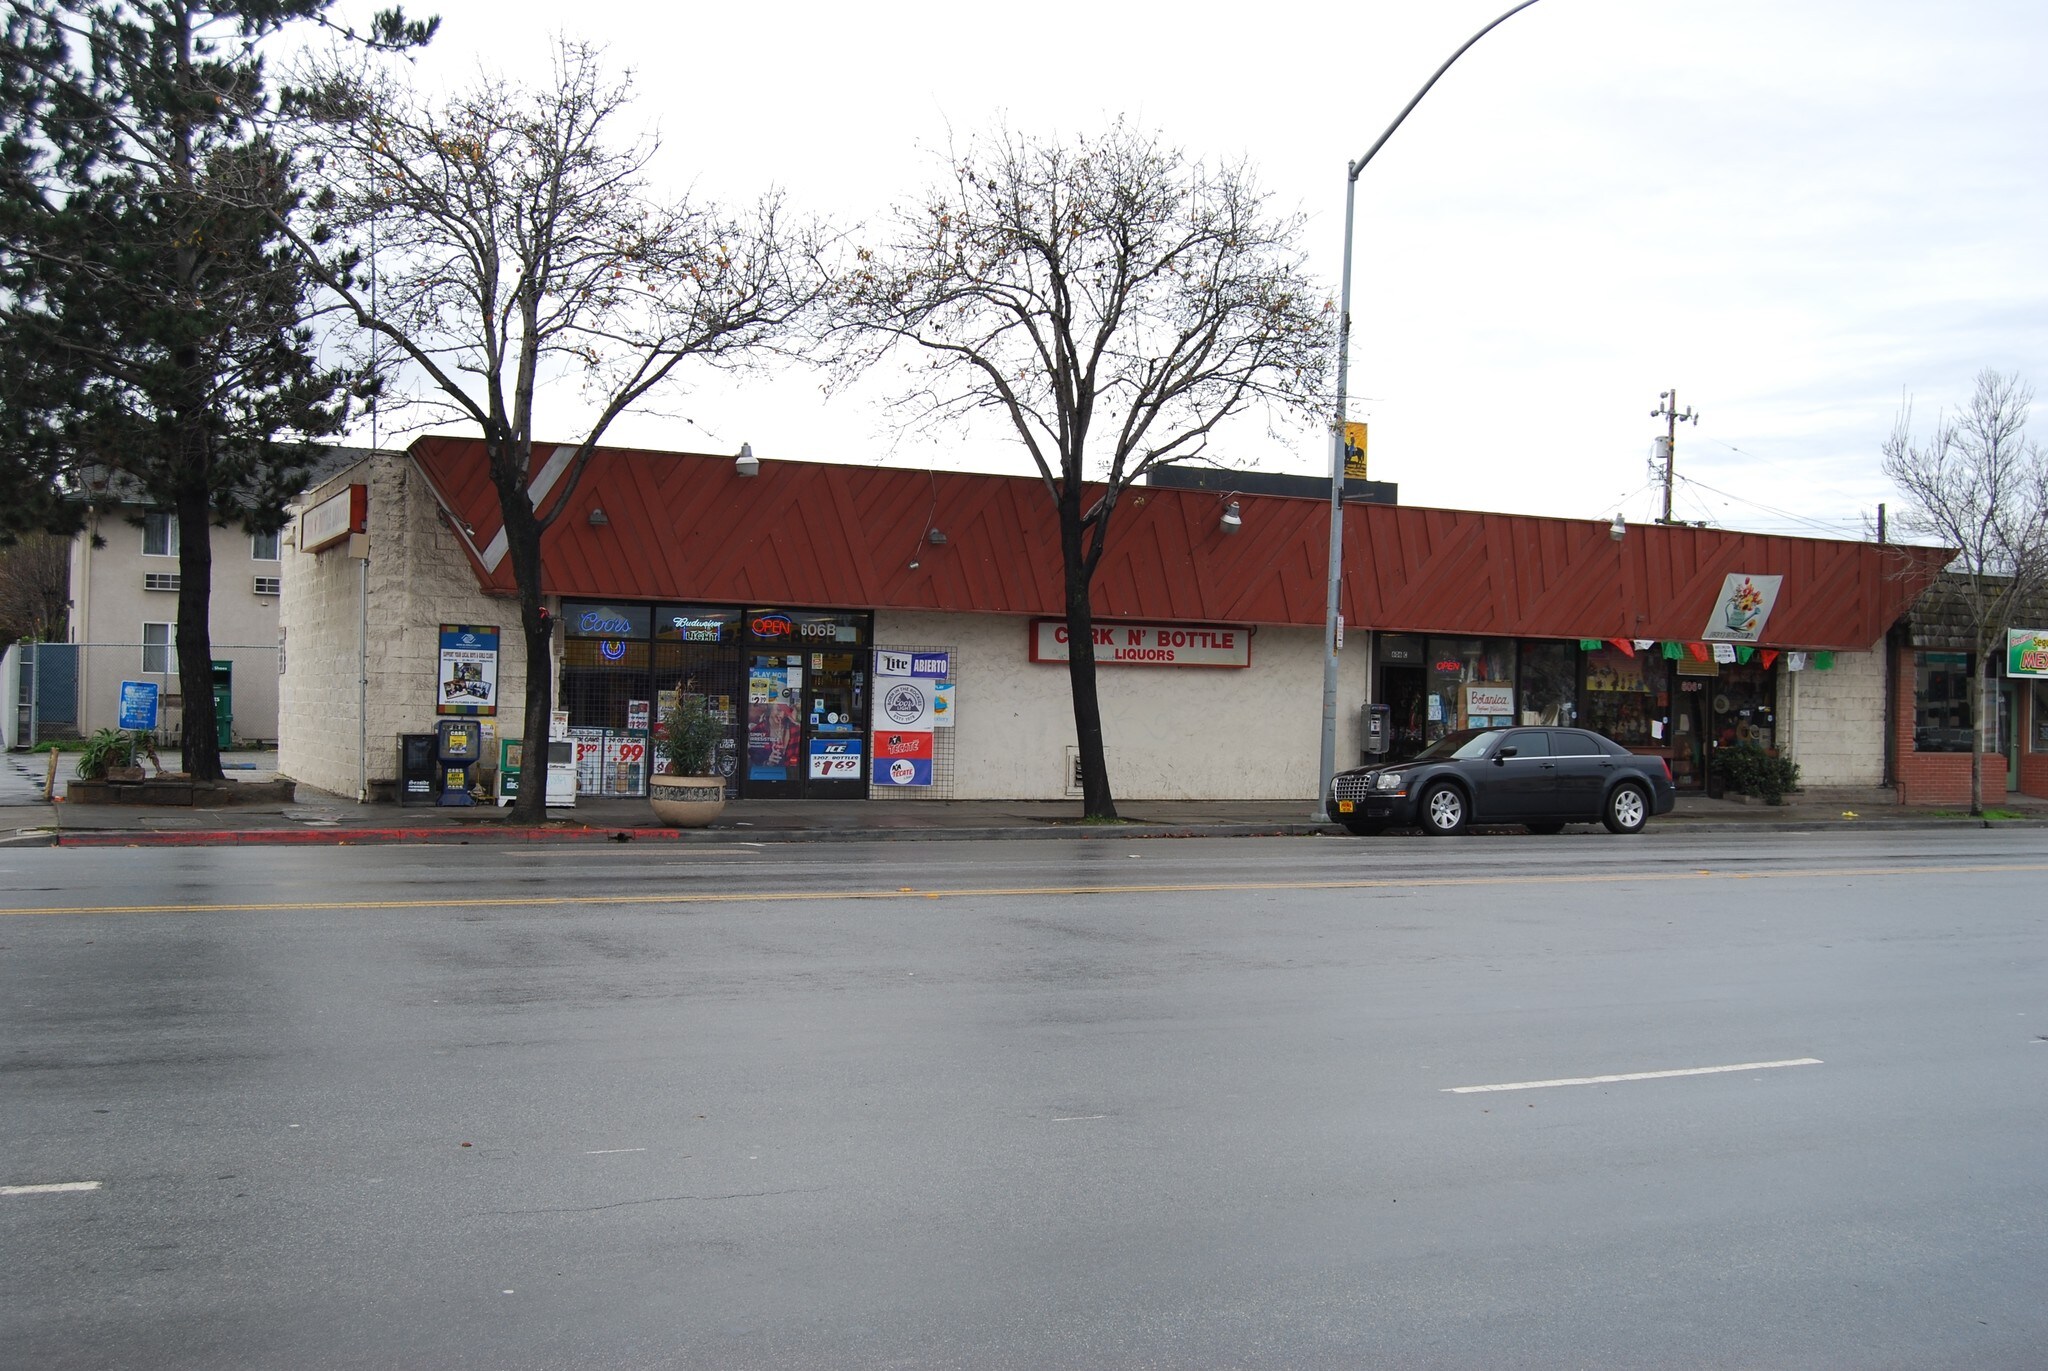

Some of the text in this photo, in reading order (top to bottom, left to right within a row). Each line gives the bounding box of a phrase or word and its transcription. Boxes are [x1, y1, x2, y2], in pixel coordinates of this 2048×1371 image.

[579, 612, 631, 632] Coors
[752, 619, 789, 634] OPEN
[686, 630, 718, 642] LIGHT
[801, 623, 836, 636] 606B
[1054, 627, 1235, 649] CRK N' BOTTLE
[1114, 648, 1175, 661] LIQUORS
[885, 656, 947, 673] Lite ABIERTO
[1436, 662, 1461, 670] OPEN
[825, 745, 847, 753] ICE
[888, 739, 920, 754] TECATE
[893, 768, 914, 778] TECATE
